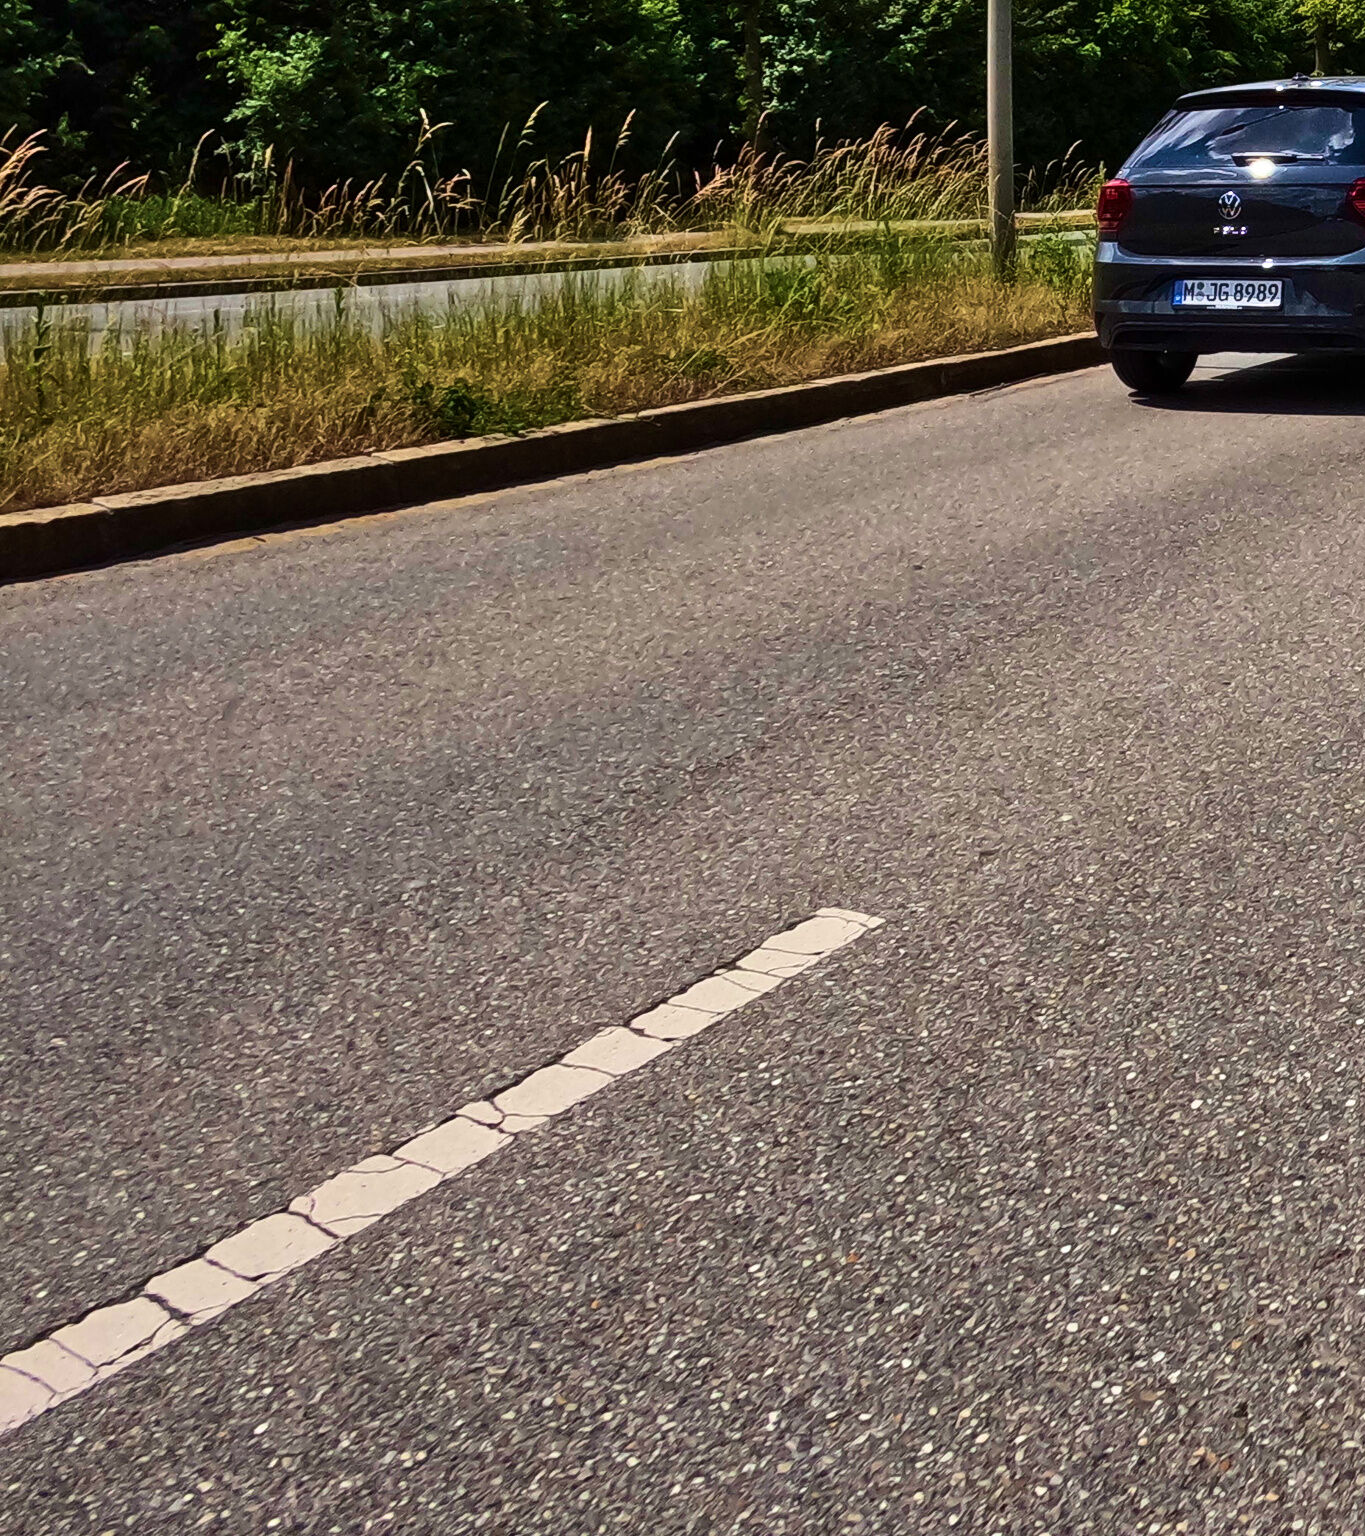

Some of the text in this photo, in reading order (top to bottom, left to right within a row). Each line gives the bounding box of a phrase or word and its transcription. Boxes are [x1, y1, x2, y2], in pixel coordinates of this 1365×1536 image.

[1183, 282, 1280, 303] M JG 8989
